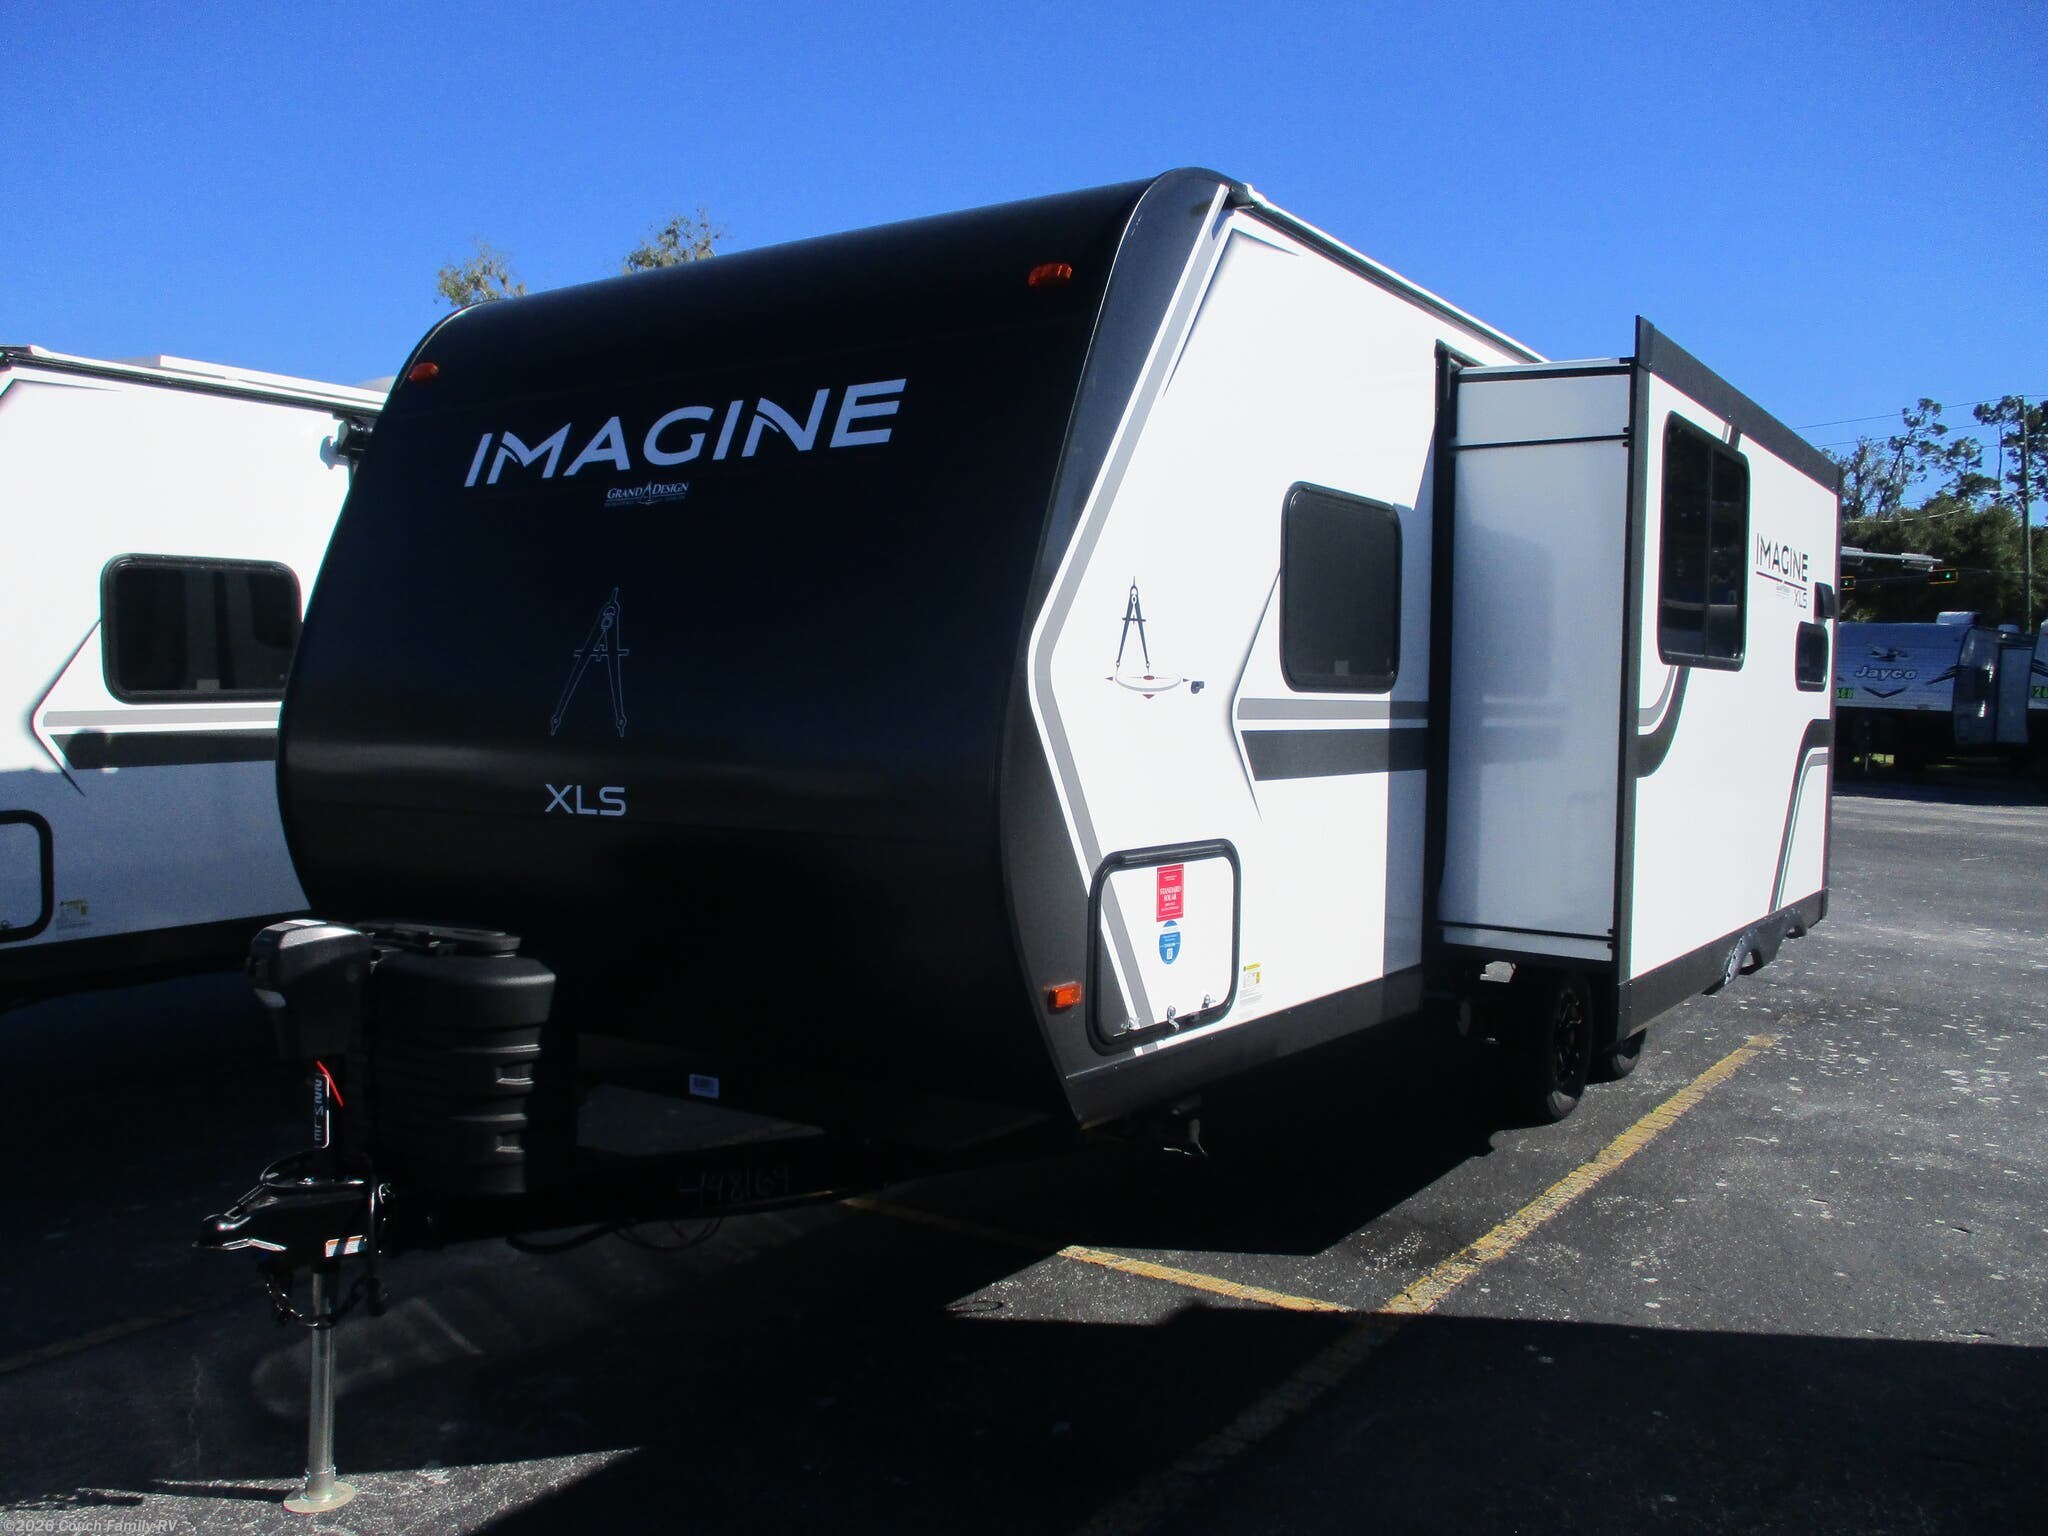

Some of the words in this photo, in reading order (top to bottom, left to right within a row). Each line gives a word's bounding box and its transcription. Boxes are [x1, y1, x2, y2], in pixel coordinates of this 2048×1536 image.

[464, 378, 907, 488] IMAGINE
[606, 487, 643, 499] GRAND
[653, 482, 689, 494] DESIGN
[1756, 533, 1808, 582] IMAGINE
[1793, 590, 1808, 608] XLS
[1856, 665, 1917, 681] Jayco
[544, 783, 626, 817] XLS
